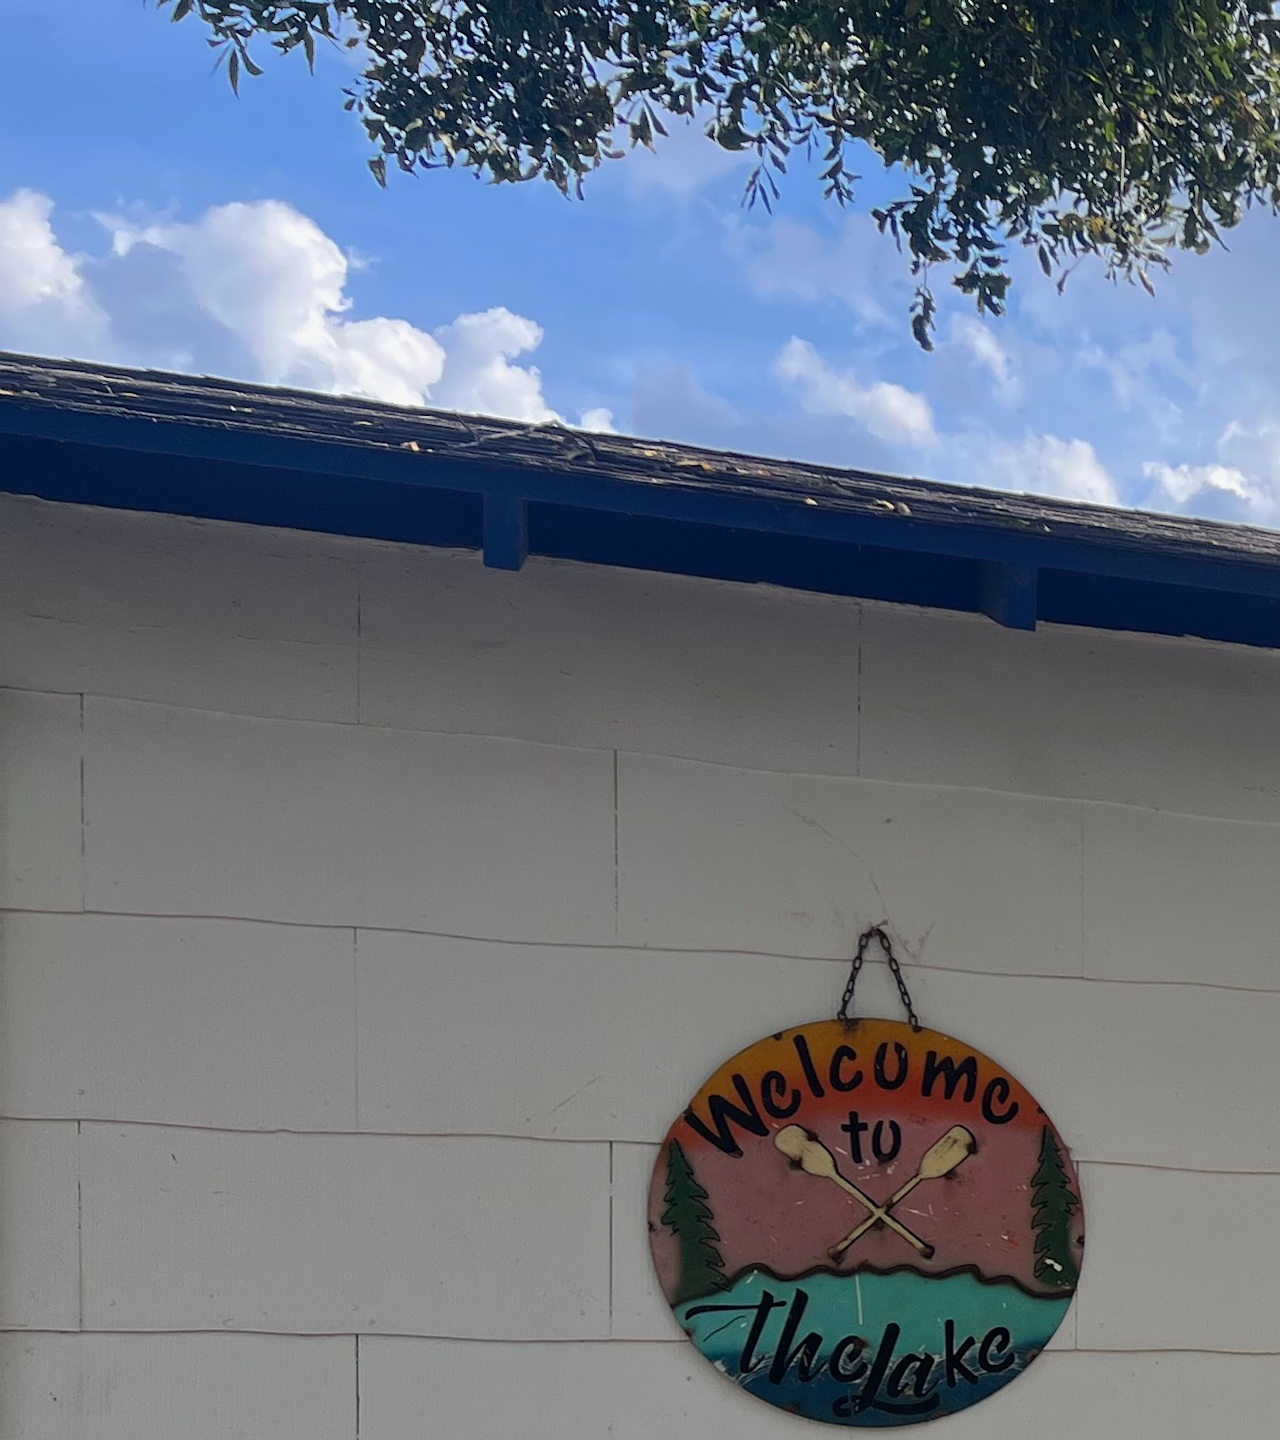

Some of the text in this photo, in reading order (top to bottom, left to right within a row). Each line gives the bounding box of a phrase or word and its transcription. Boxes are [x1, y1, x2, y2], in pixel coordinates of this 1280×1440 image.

[684, 1034, 1019, 1158] Welcome
[841, 1111, 901, 1163] to
[685, 1289, 1016, 1417] The Lake
